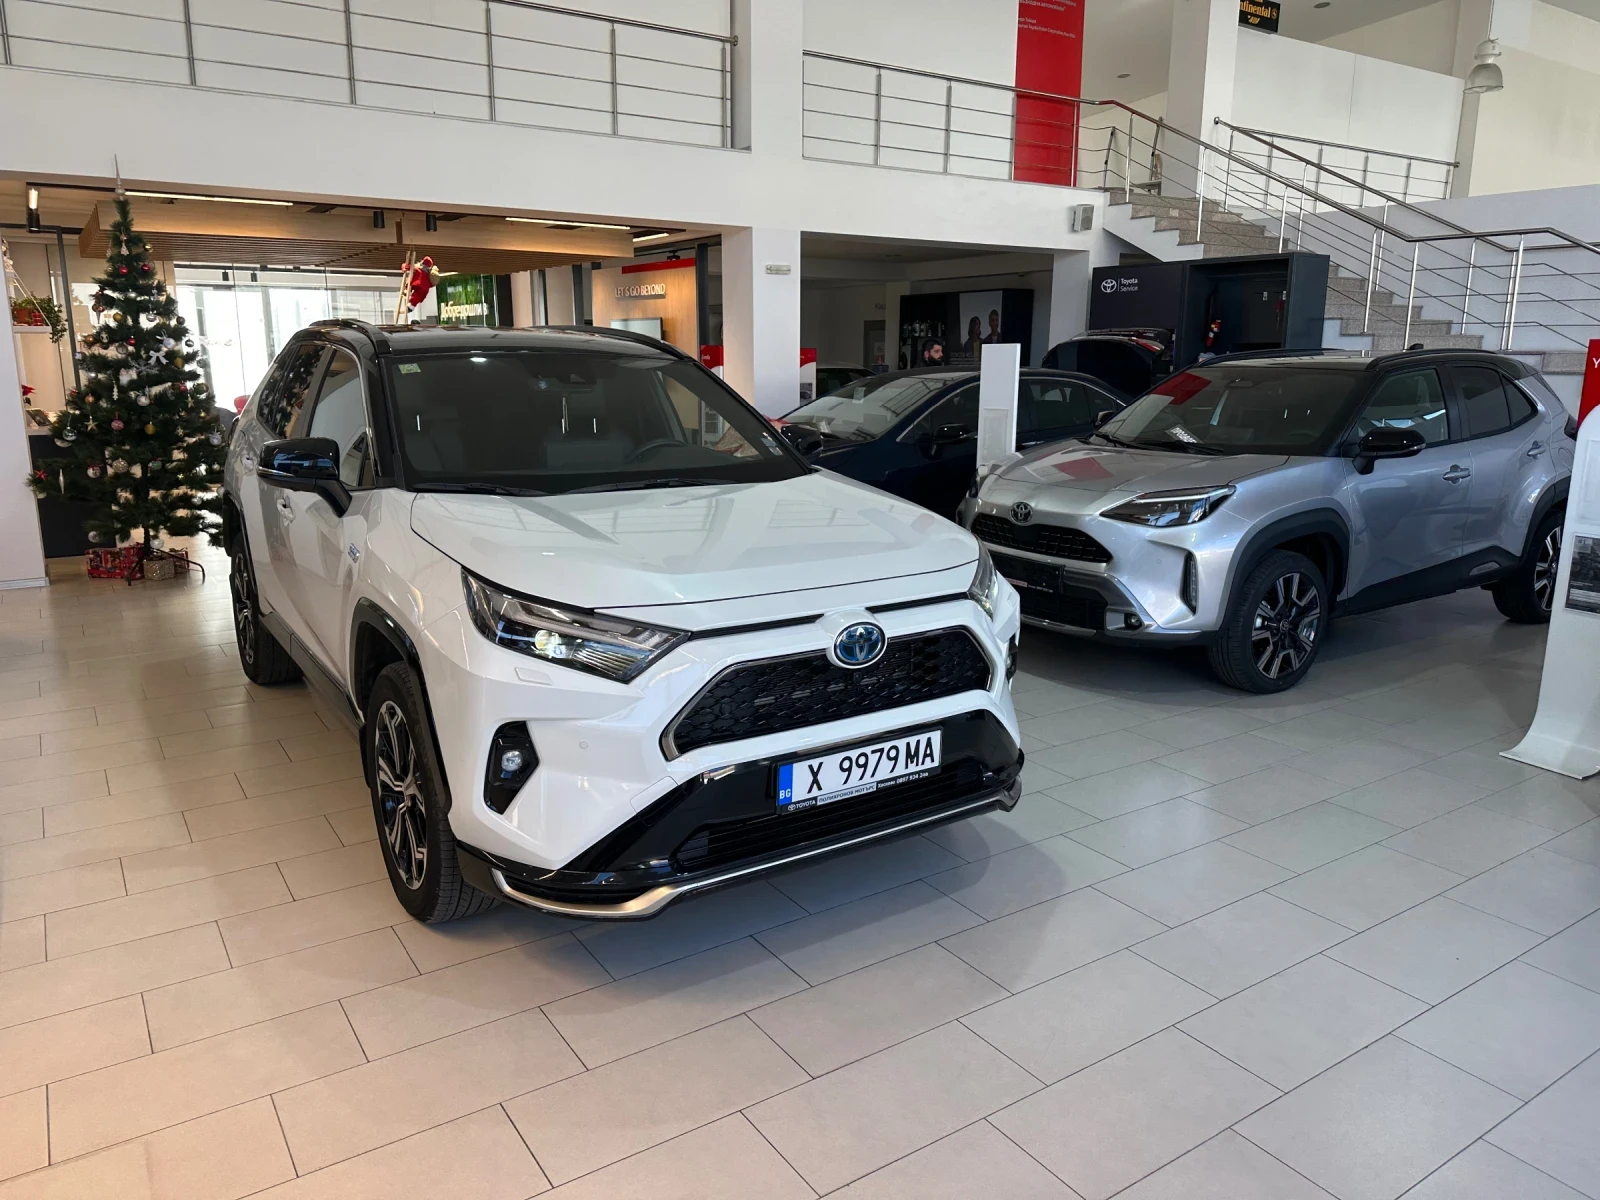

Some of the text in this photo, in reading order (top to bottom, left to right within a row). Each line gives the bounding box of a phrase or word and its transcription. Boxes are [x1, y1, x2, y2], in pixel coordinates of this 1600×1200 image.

[615, 283, 666, 297] LET'S GO BEYOND
[807, 737, 934, 794] X 9979 MA
[779, 788, 792, 800] BG
[796, 800, 816, 809] TOYOTA
